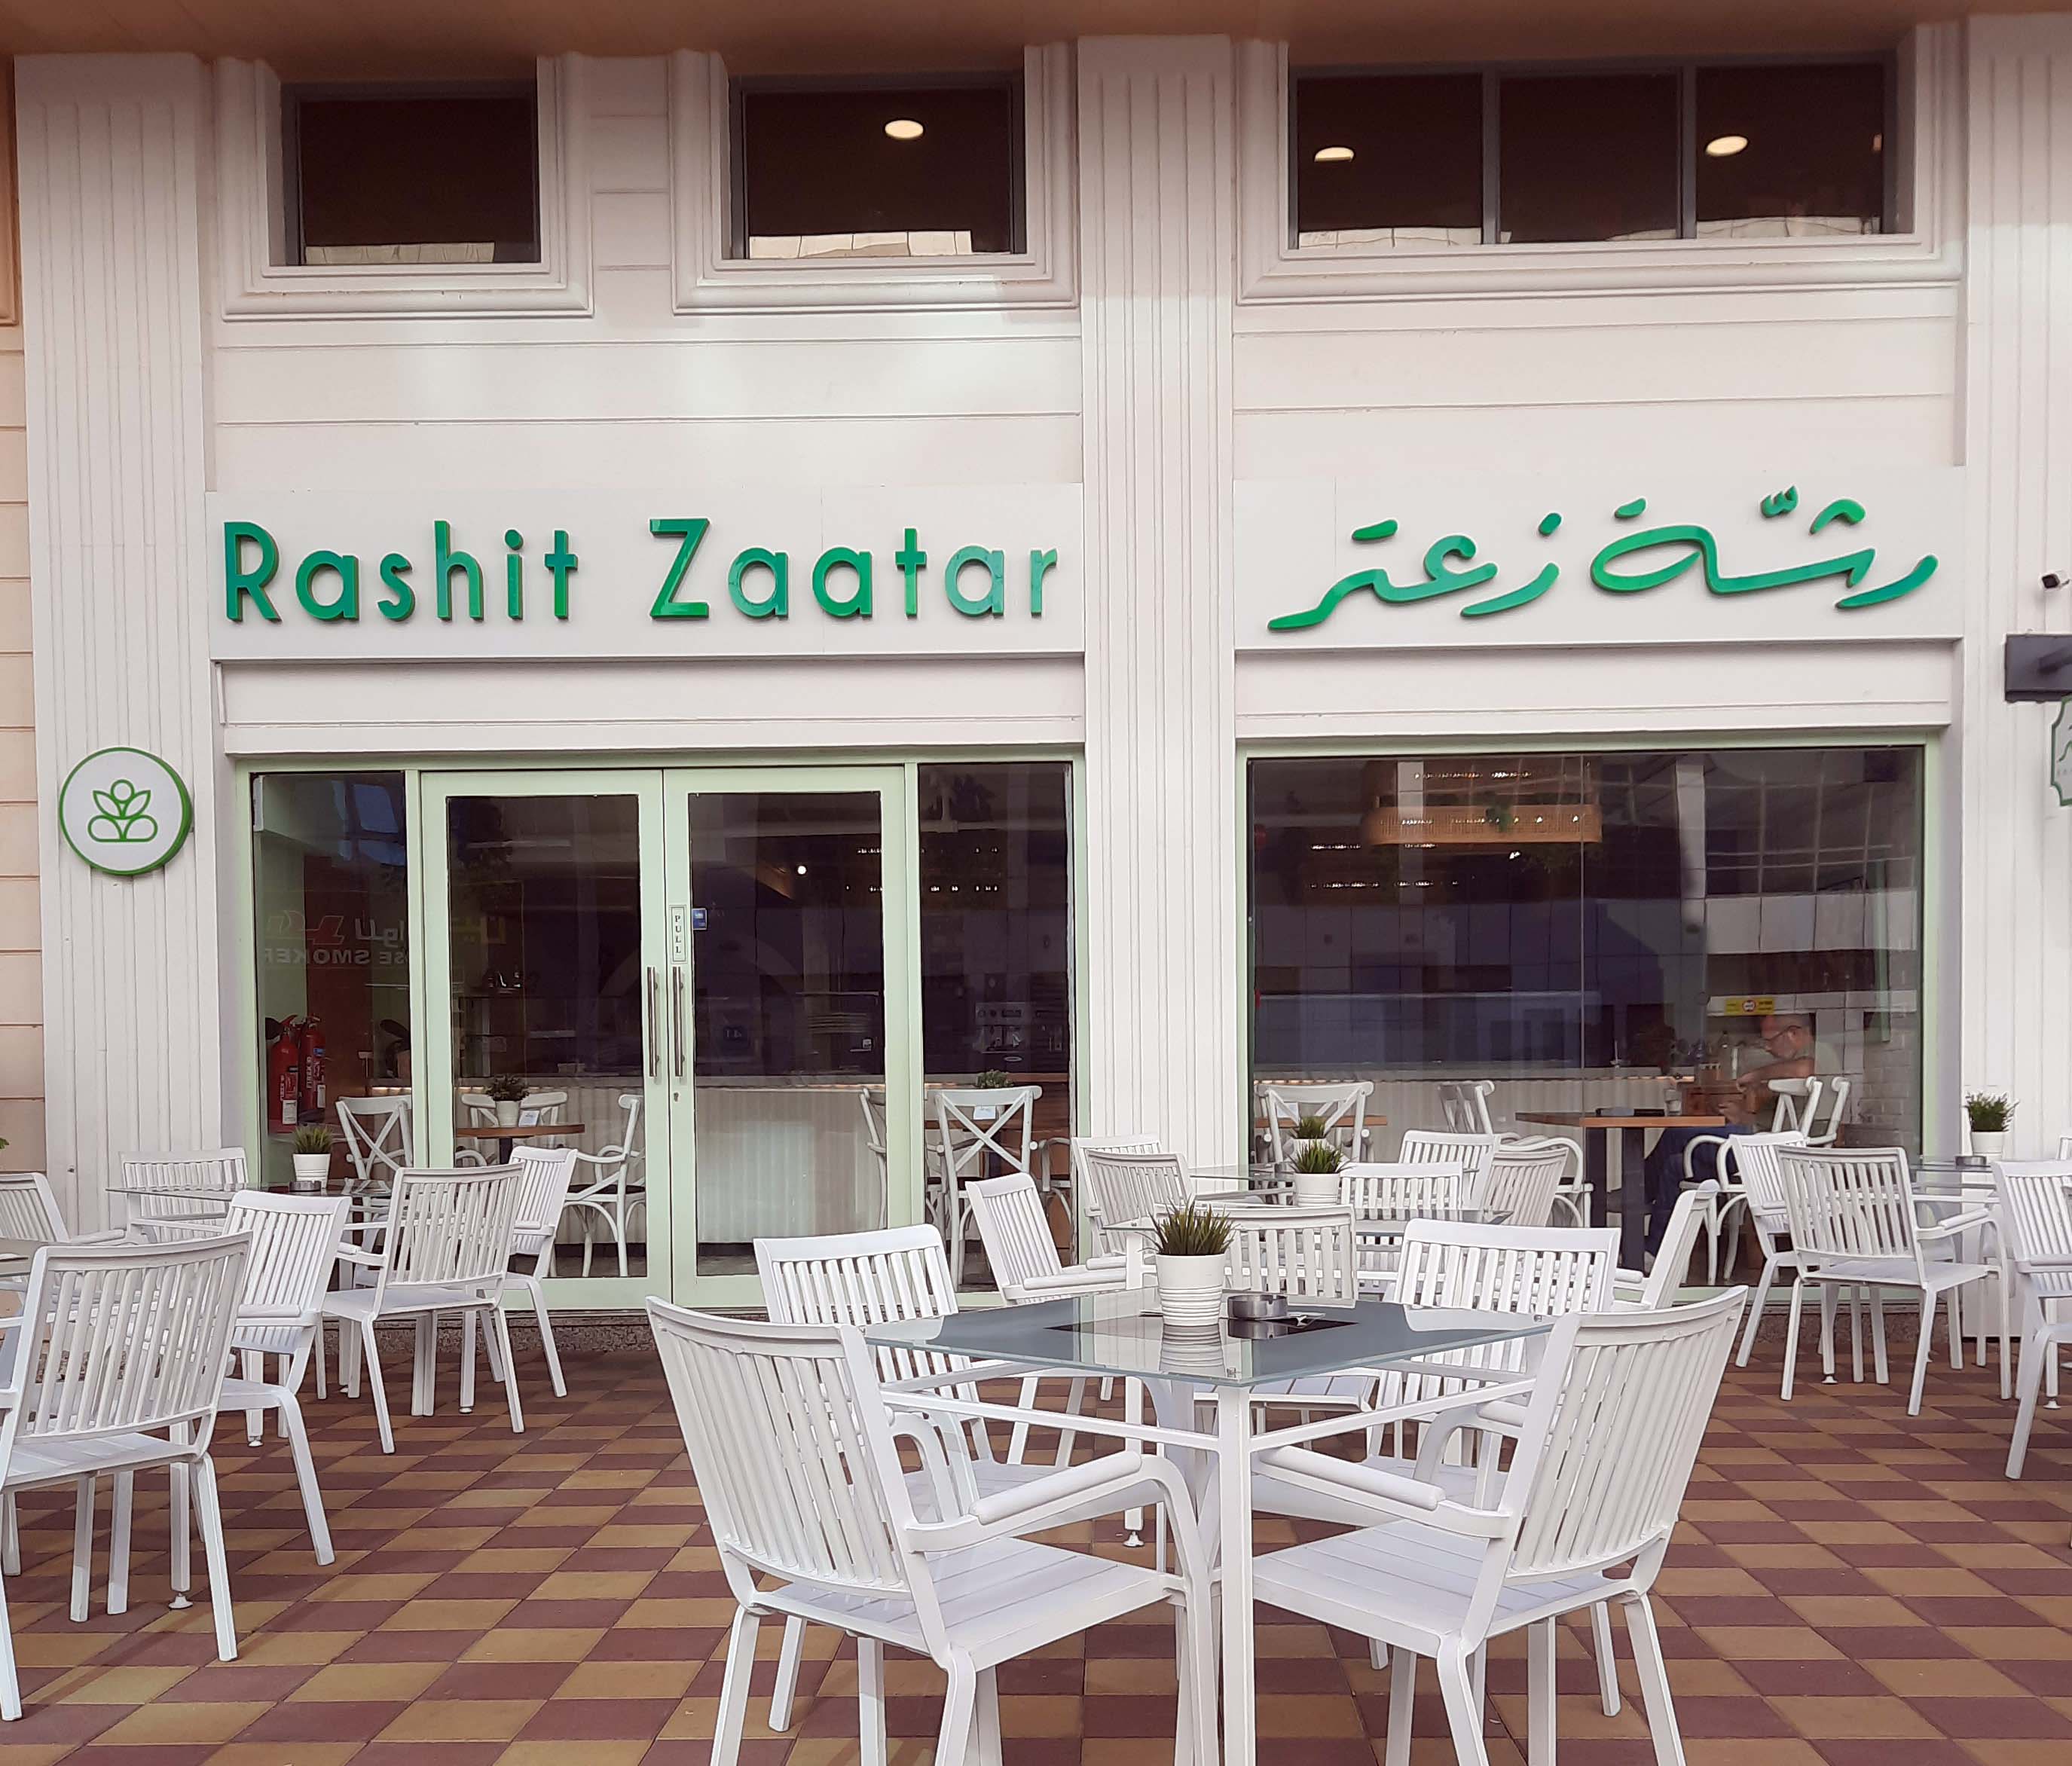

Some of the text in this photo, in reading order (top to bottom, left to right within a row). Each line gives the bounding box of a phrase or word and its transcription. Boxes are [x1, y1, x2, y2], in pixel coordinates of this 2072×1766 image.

[223, 517, 1057, 625] Rashit Zaatar
[1267, 512, 1563, 633] زعتر
